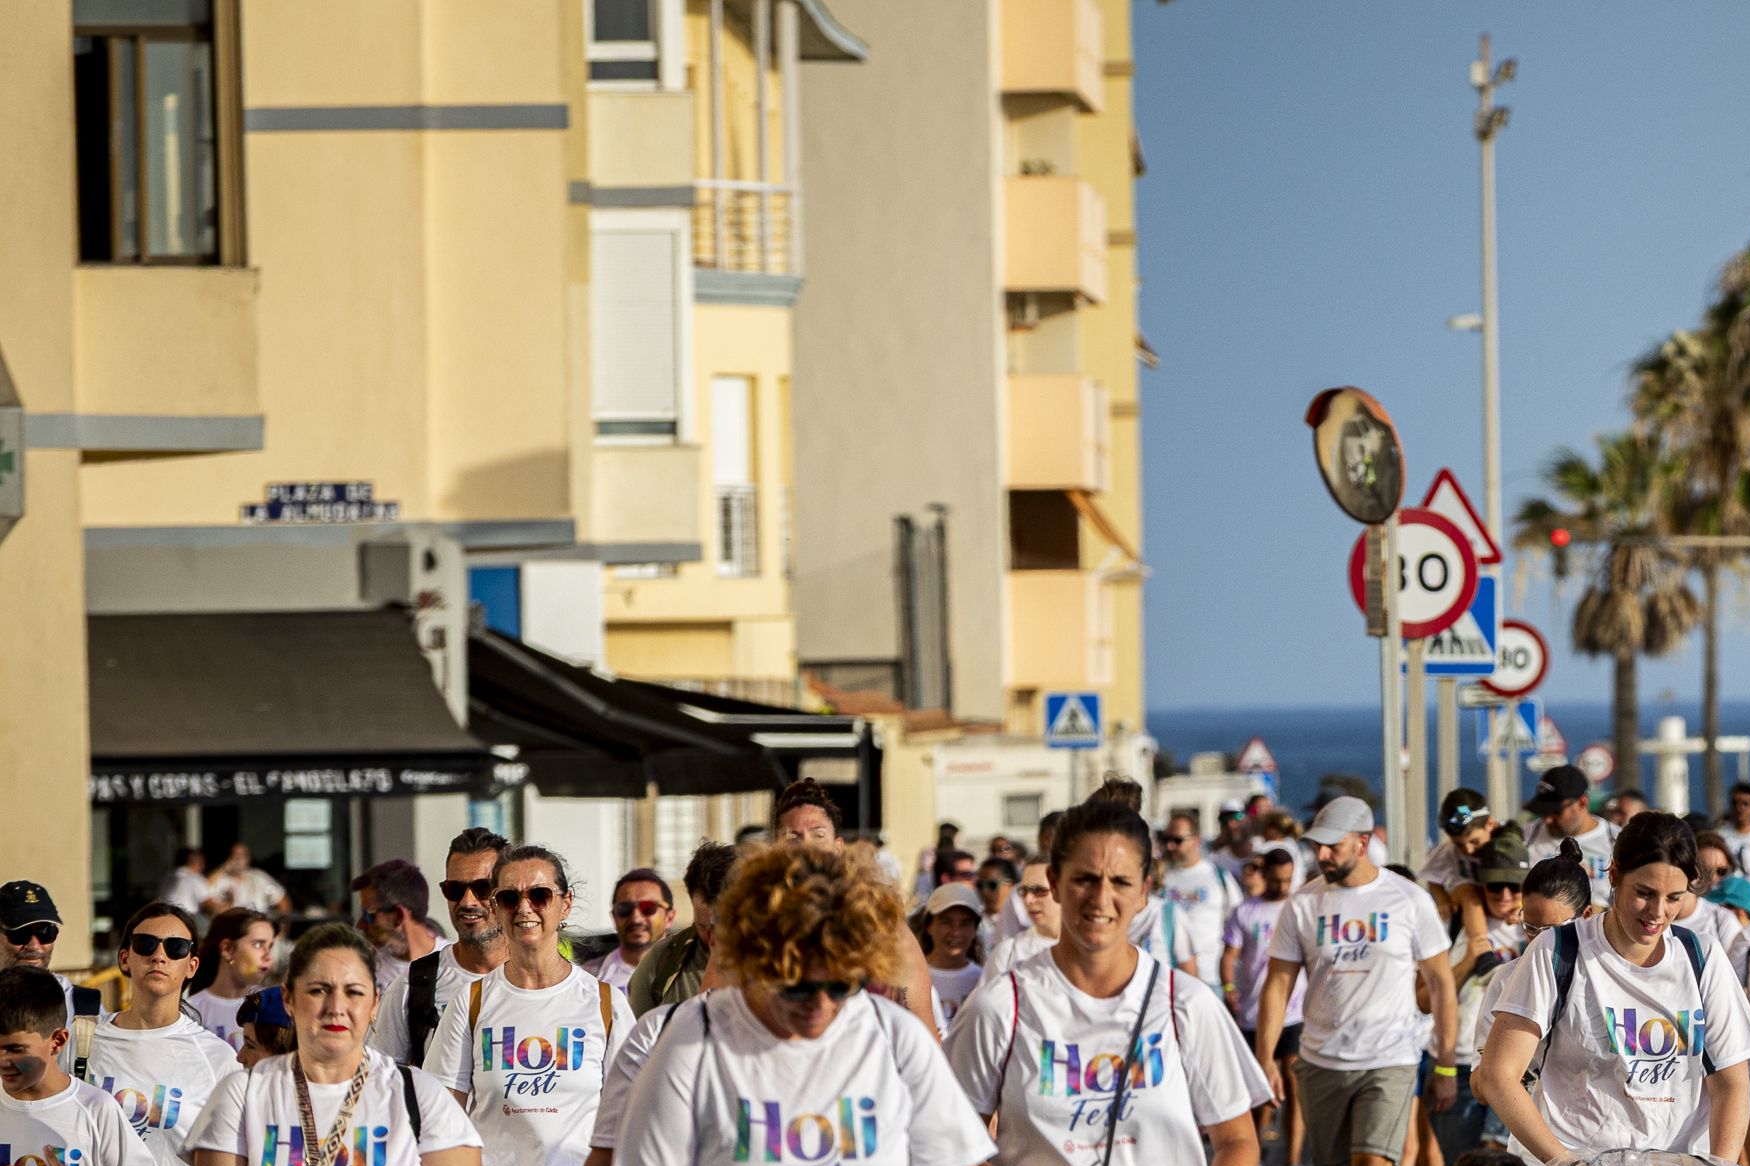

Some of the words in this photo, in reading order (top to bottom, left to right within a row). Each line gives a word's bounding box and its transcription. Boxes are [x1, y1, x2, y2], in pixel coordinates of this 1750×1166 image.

[268, 484, 335, 502] PLAZA
[1316, 912, 1389, 947] Holi
[482, 1026, 586, 1072] Holi
[1605, 1006, 1705, 1057] Holi
[504, 1069, 561, 1099] Fest
[1625, 1057, 1681, 1085] Fest
[732, 1096, 877, 1162] Holi
